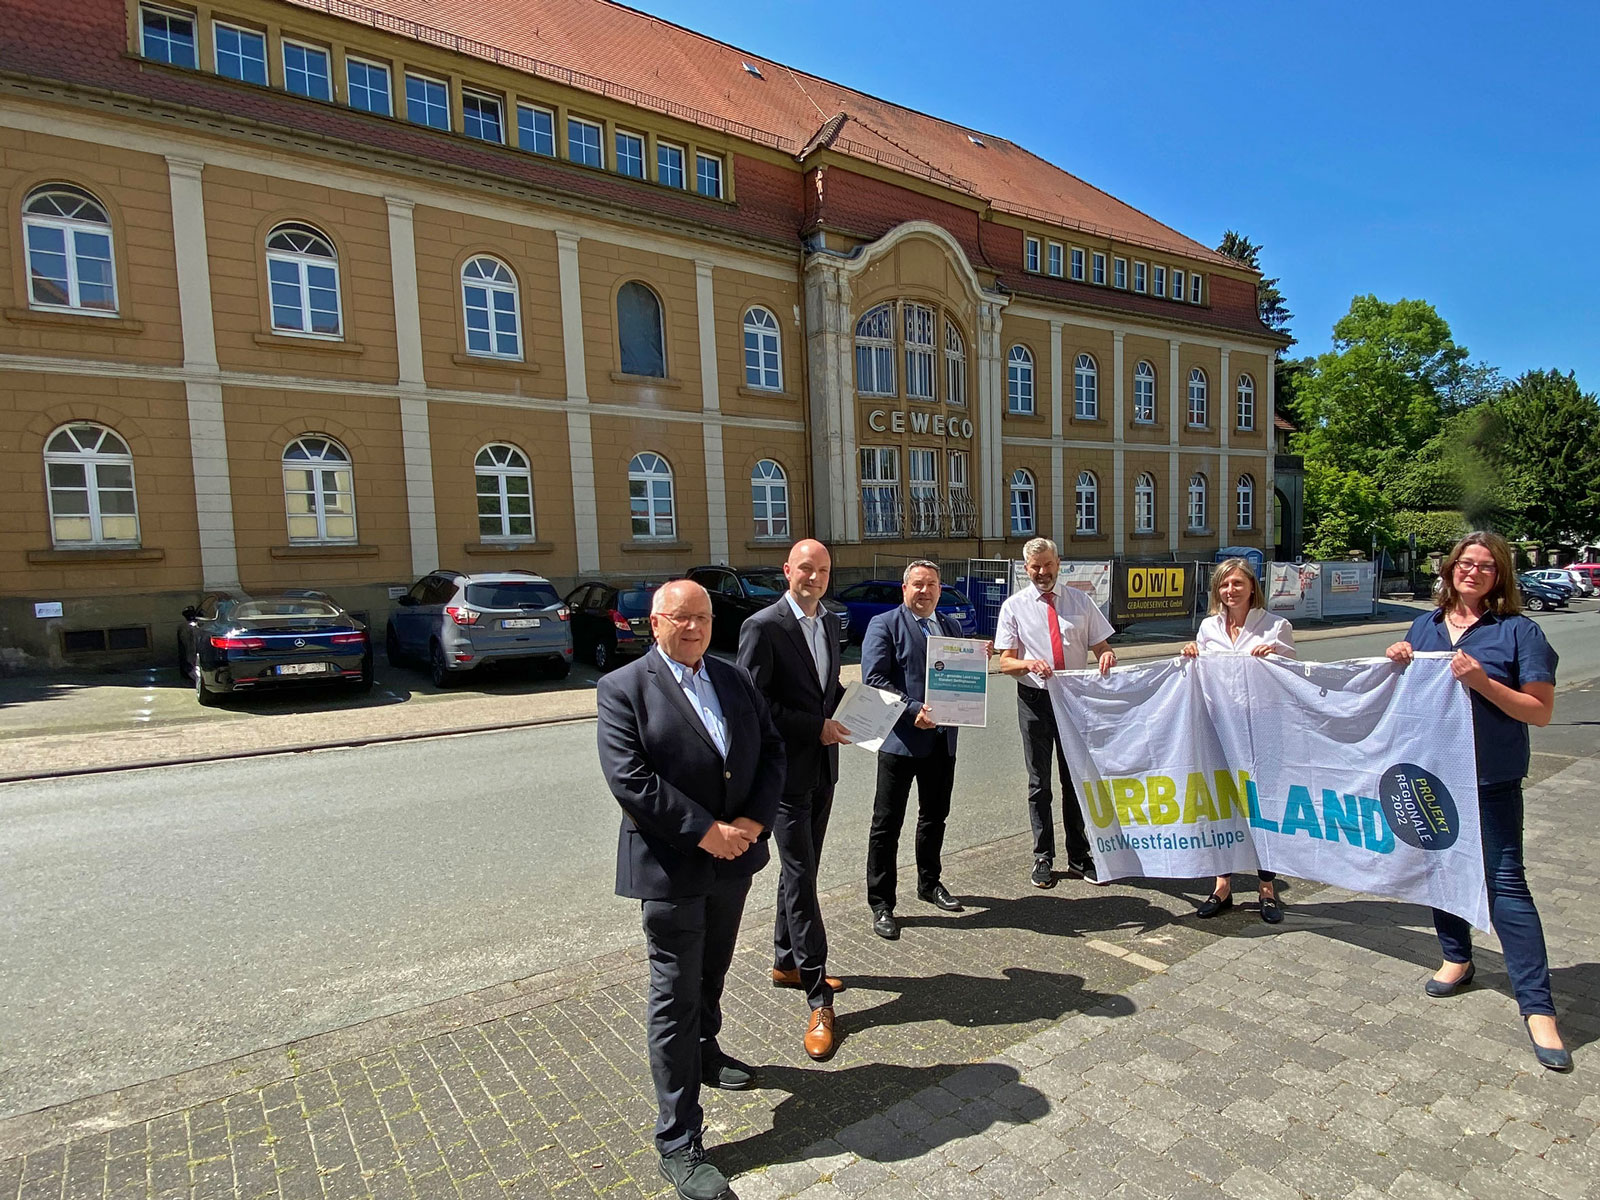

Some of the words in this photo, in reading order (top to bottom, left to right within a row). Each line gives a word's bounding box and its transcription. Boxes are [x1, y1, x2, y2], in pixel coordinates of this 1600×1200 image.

[868, 409, 974, 439] CEWECO
[1131, 572, 1179, 594] OWL
[1127, 599, 1169, 610] GEBÄUDESERVICE
[1169, 599, 1183, 608] GmbH
[1083, 768, 1396, 855] URBANLAND
[1390, 794, 1408, 826] 2022
[1395, 774, 1433, 843] REGIONALE
[1416, 778, 1451, 834] PROJEKT
[1097, 829, 1246, 855] OstWestfalenLippe
